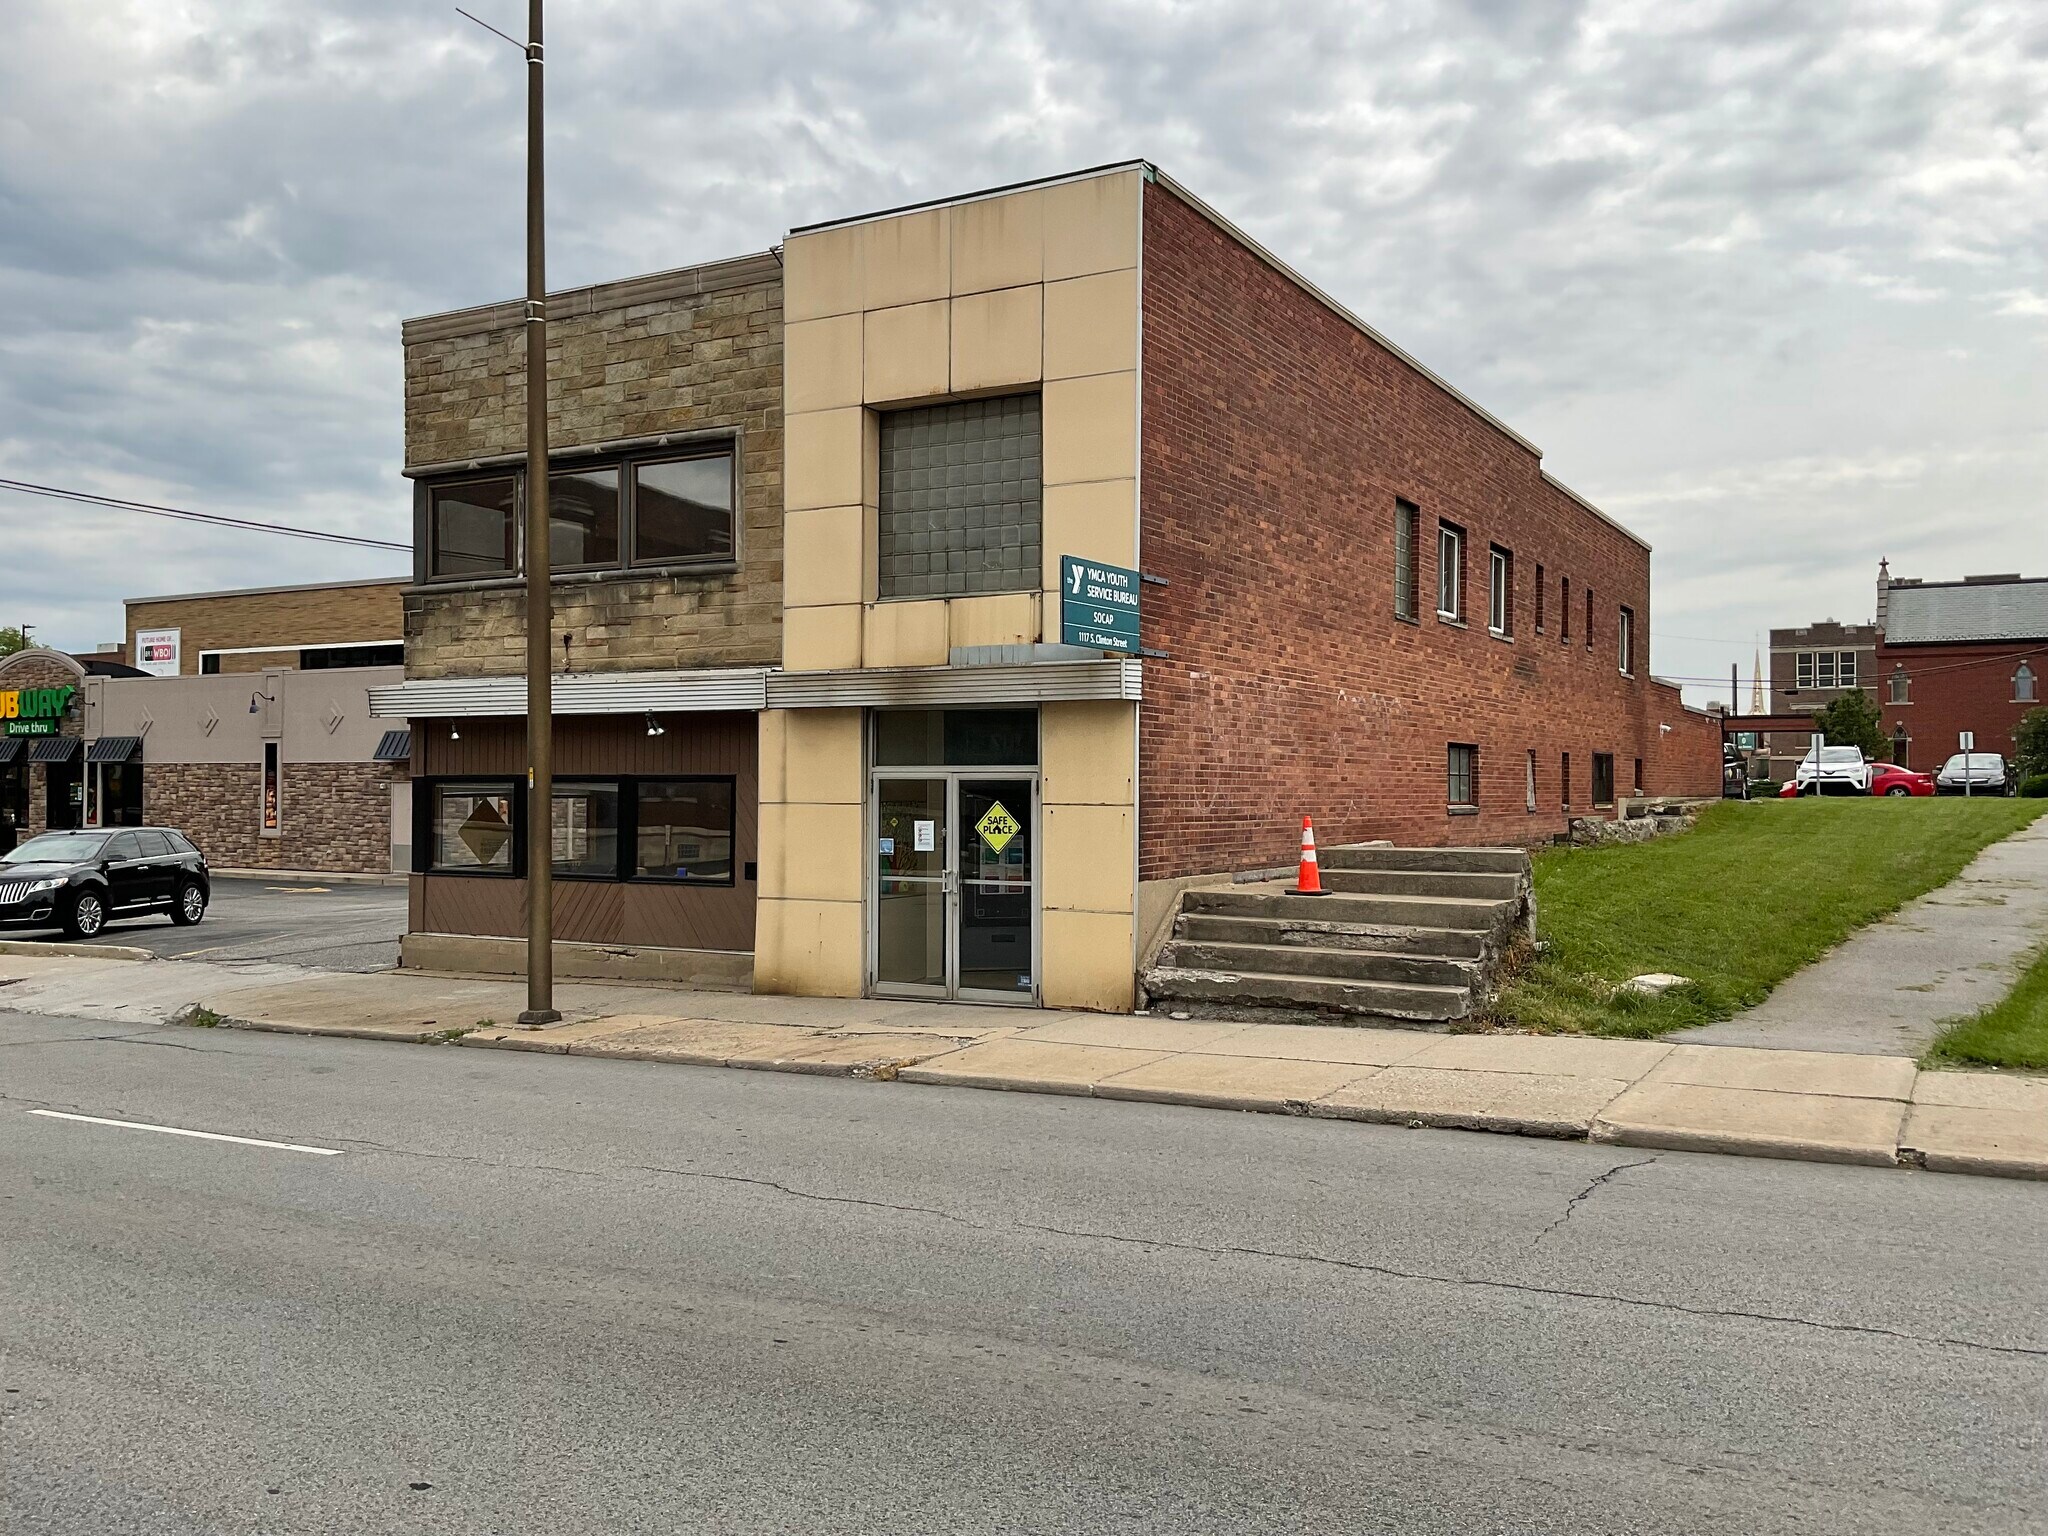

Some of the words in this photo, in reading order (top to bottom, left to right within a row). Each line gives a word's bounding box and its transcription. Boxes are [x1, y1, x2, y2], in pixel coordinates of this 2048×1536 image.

[1087, 568, 1106, 583] YMCA
[1106, 572, 1128, 587] YOUTH
[1087, 585, 1112, 601] SERVICE
[1113, 590, 1138, 606] BUREAU
[1093, 611, 1114, 625] SOCAP
[1078, 632, 1089, 642] 1117
[1096, 634, 1112, 646] Clinton
[1113, 637, 1128, 648] Street
[153, 648, 170, 658] WBOI
[10, 722, 30, 733] Drive
[31, 721, 48, 733] thru
[987, 815, 1008, 825] SAFE
